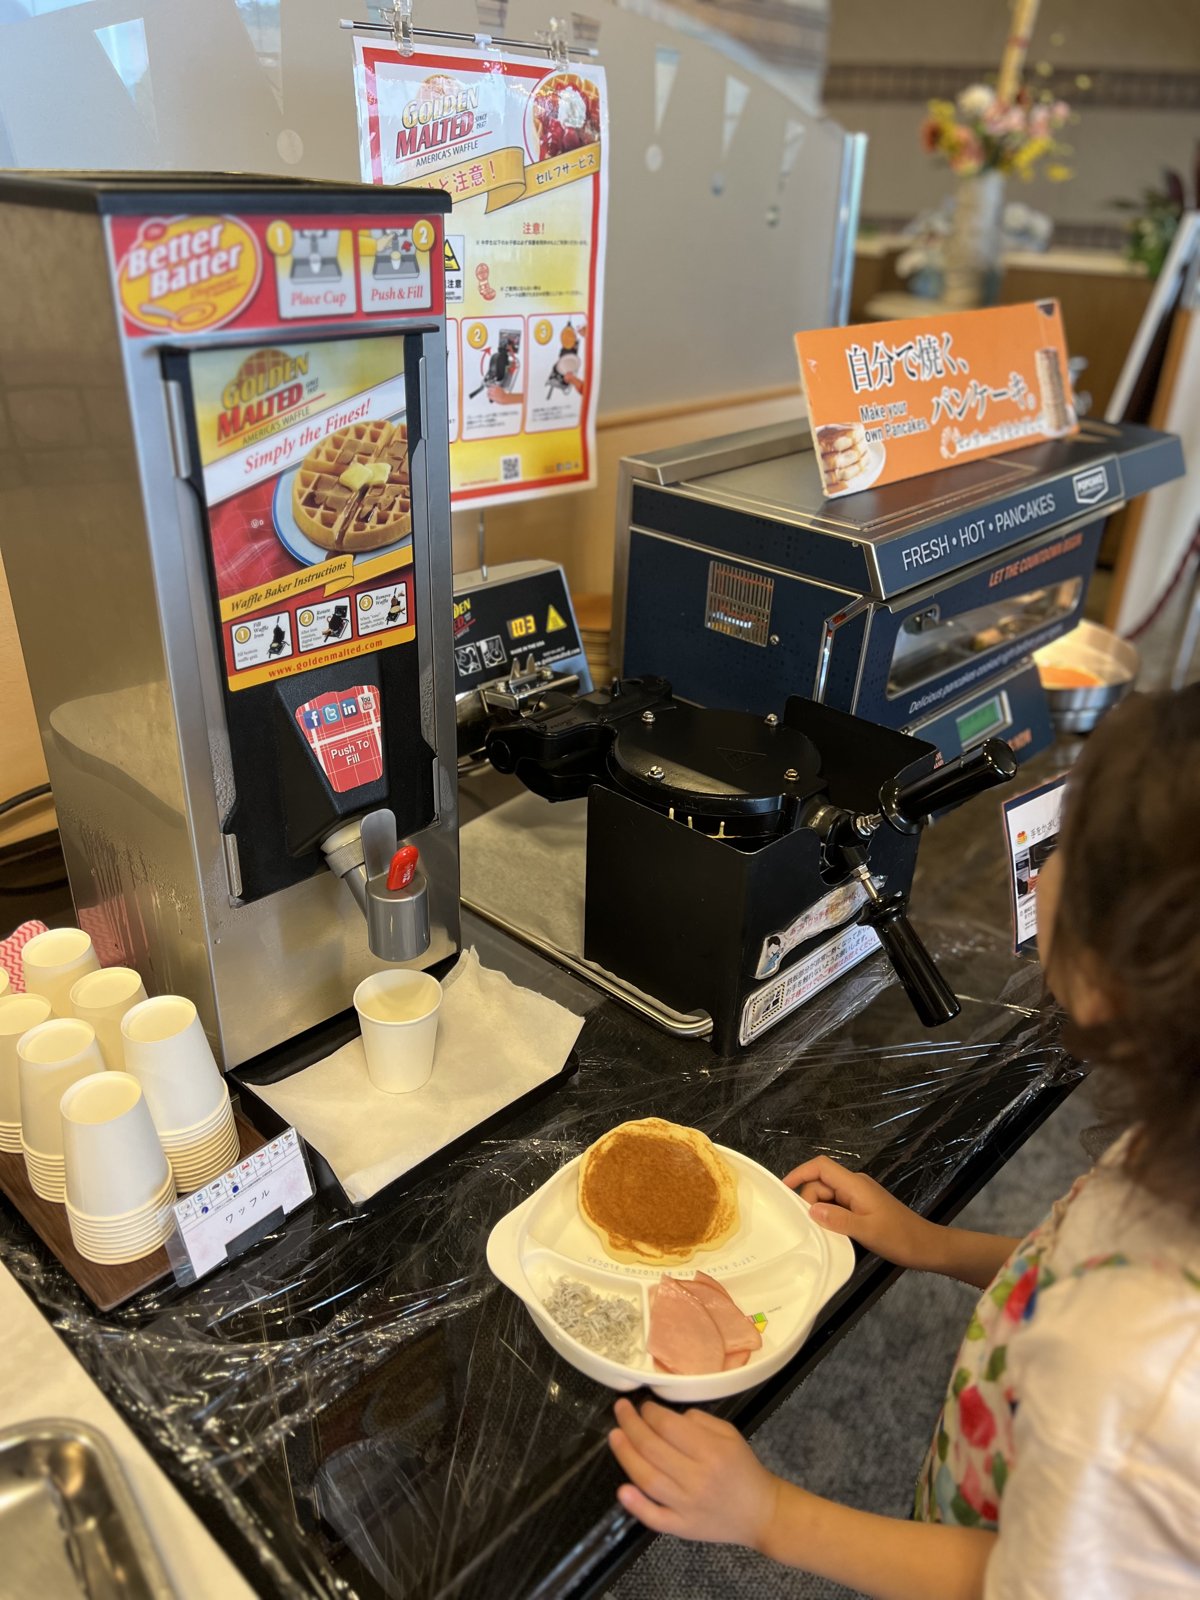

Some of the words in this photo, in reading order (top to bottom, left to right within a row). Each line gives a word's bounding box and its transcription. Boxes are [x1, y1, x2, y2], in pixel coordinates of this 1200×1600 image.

[402, 86, 479, 129] GOLDEN
[396, 111, 474, 159] MALTED
[415, 147, 452, 168] AMERICA'S
[452, 140, 479, 156] WAFFLE
[535, 153, 596, 185] セルフサービス
[127, 222, 224, 280] Better
[275, 227, 284, 247] 1
[418, 226, 429, 246] 2
[150, 243, 243, 301] Batter
[290, 290, 320, 307] Place
[323, 290, 347, 308] Cup
[371, 288, 396, 302] Push
[396, 290, 406, 301] &
[406, 286, 424, 300] Fill
[474, 327, 481, 342] 2
[539, 325, 547, 339] 3
[845, 332, 970, 393] 自分で焼く、
[222, 352, 310, 410] GOLDEN
[217, 382, 304, 442] MALTED
[859, 404, 886, 423] Make
[887, 402, 908, 417] your
[930, 371, 1036, 425] パンケーキ。
[242, 420, 282, 446] AMERICA'S
[281, 406, 310, 428] WAFFLE
[244, 434, 296, 474] Simply
[299, 424, 321, 446] the
[325, 397, 371, 434] Finest!
[865, 429, 884, 443] own
[885, 418, 930, 438] Pancakes.
[902, 534, 950, 571] FRESH
[958, 520, 986, 549] HOT
[995, 494, 1056, 533] PANCAKES
[230, 592, 263, 612] Waffle
[263, 579, 292, 599] Baker
[293, 560, 347, 588] Instructions
[363, 596, 369, 607] 3
[303, 613, 310, 623] 2
[240, 630, 246, 639] 1
[268, 638, 383, 678] www.goldenmalted.com
[342, 701, 357, 715] in
[331, 743, 356, 760] Push
[356, 740, 370, 751] To
[346, 754, 361, 766] Fill
[225, 1188, 271, 1224] ワッフル
